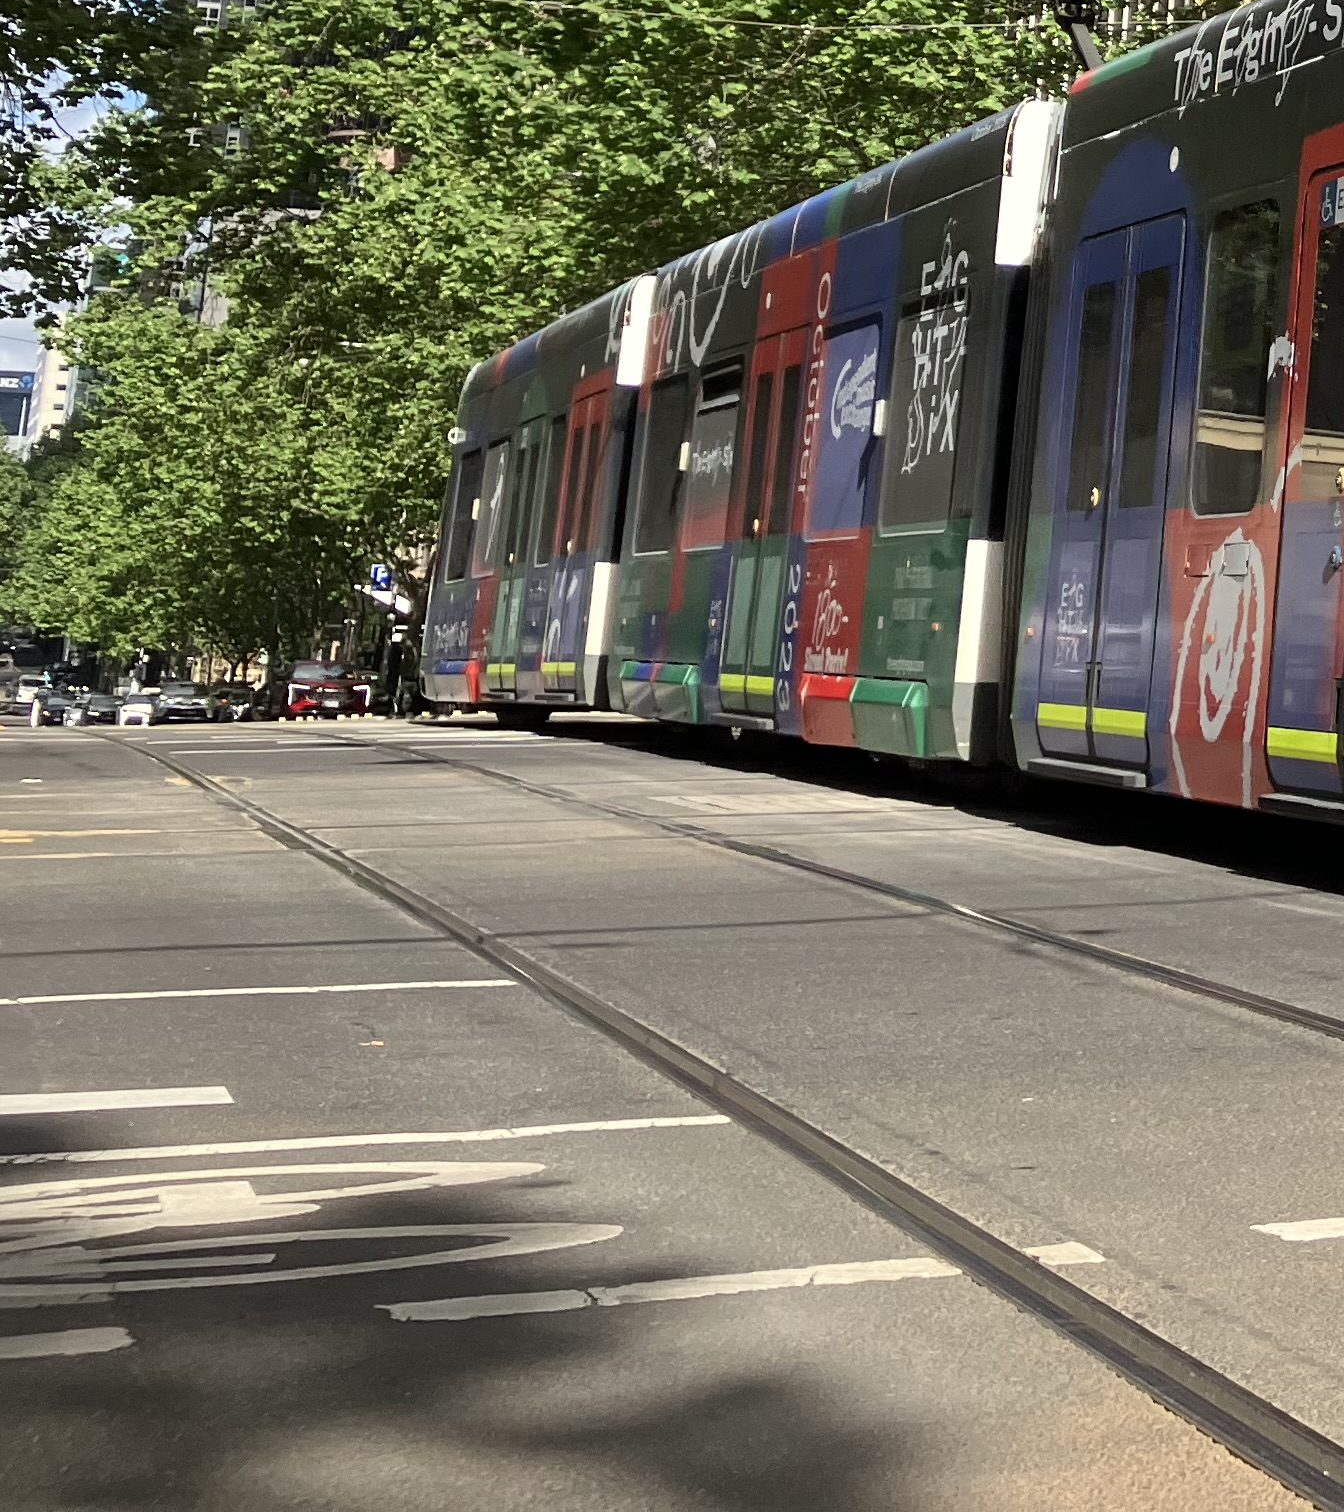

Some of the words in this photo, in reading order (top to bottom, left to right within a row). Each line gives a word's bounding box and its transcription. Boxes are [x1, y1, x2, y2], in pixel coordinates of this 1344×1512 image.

[1174, 16, 1216, 120] The
[797, 271, 833, 504] October
[776, 563, 802, 713] 2023
